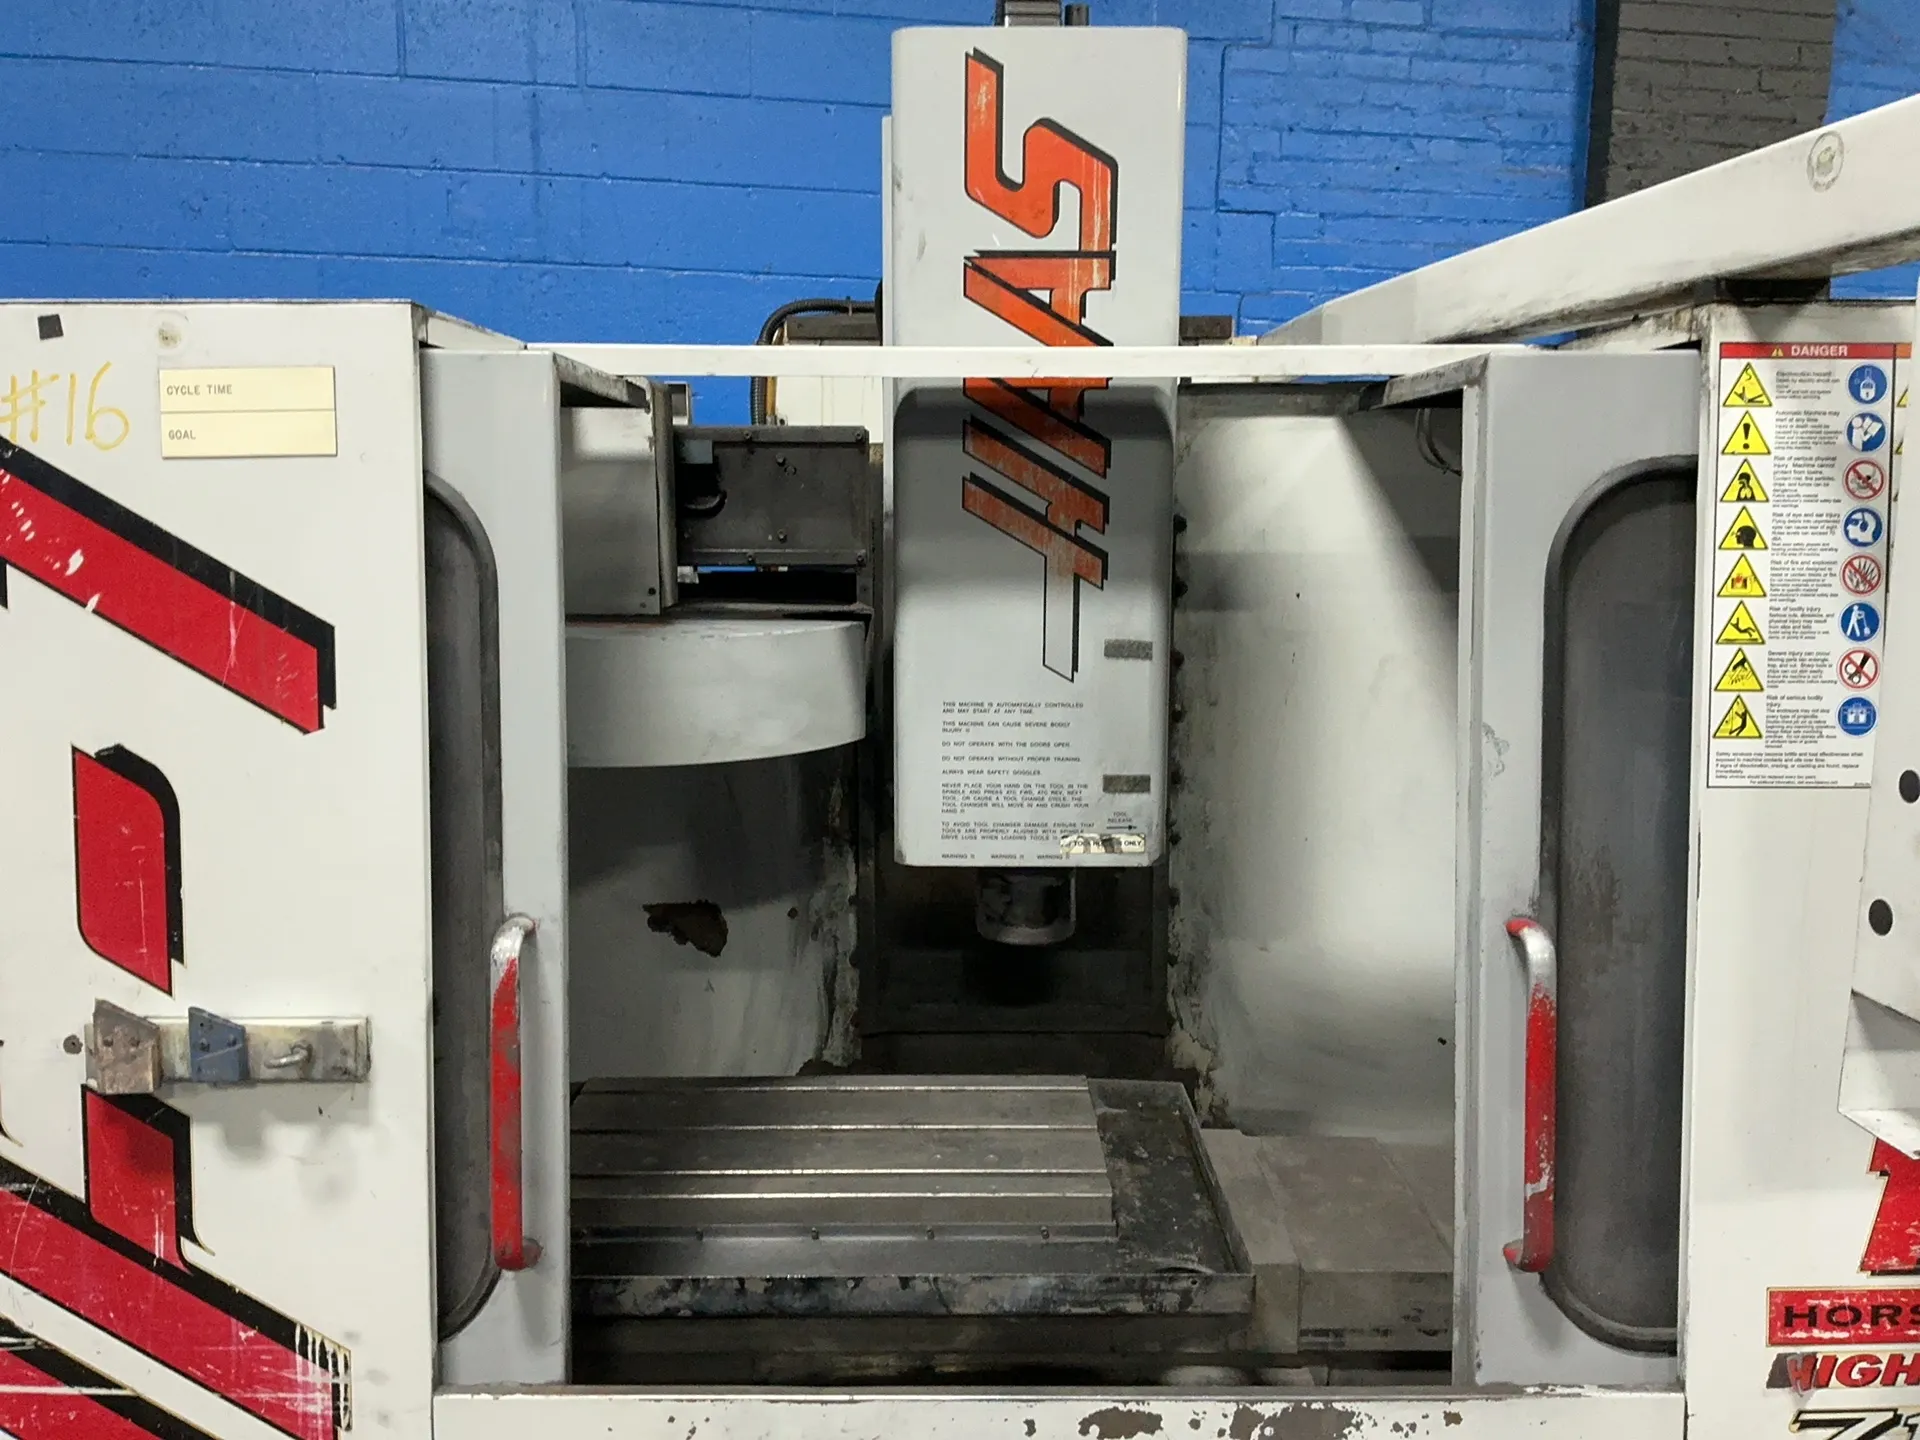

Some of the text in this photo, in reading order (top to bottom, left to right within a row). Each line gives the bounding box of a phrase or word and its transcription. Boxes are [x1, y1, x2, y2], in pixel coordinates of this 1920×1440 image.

[1790, 345, 1848, 356] DANGER
[963, 47, 1119, 682] HAAS
[166, 384, 233, 396] CYCLE TIME
[0, 361, 130, 450] #16
[168, 430, 196, 440] GOAL
